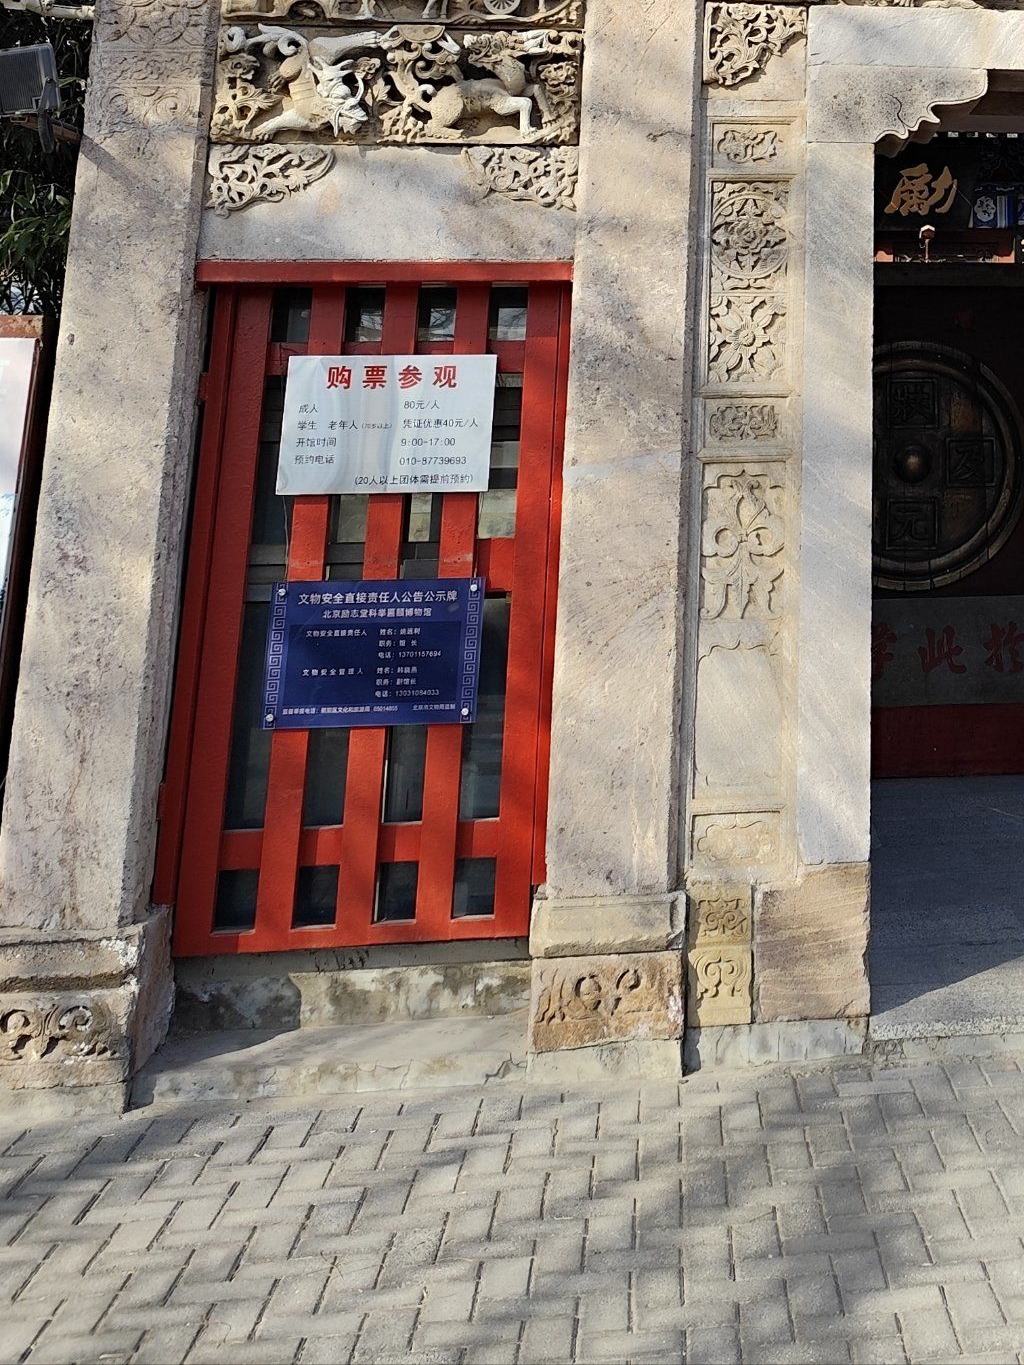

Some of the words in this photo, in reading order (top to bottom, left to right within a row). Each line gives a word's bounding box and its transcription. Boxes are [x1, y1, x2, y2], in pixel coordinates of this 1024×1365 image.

[326, 364, 458, 390] 购票参观
[298, 403, 319, 414] 成人
[403, 399, 441, 410] 80元/人
[297, 419, 318, 431] 学生
[402, 417, 479, 429] 凭证优惠40元/人
[295, 436, 337, 448] 开馆时间
[400, 437, 456, 447] 9:00-17:00
[294, 454, 335, 466] 预约电话
[298, 590, 459, 606] 文物安全直接责任人公告公示牌
